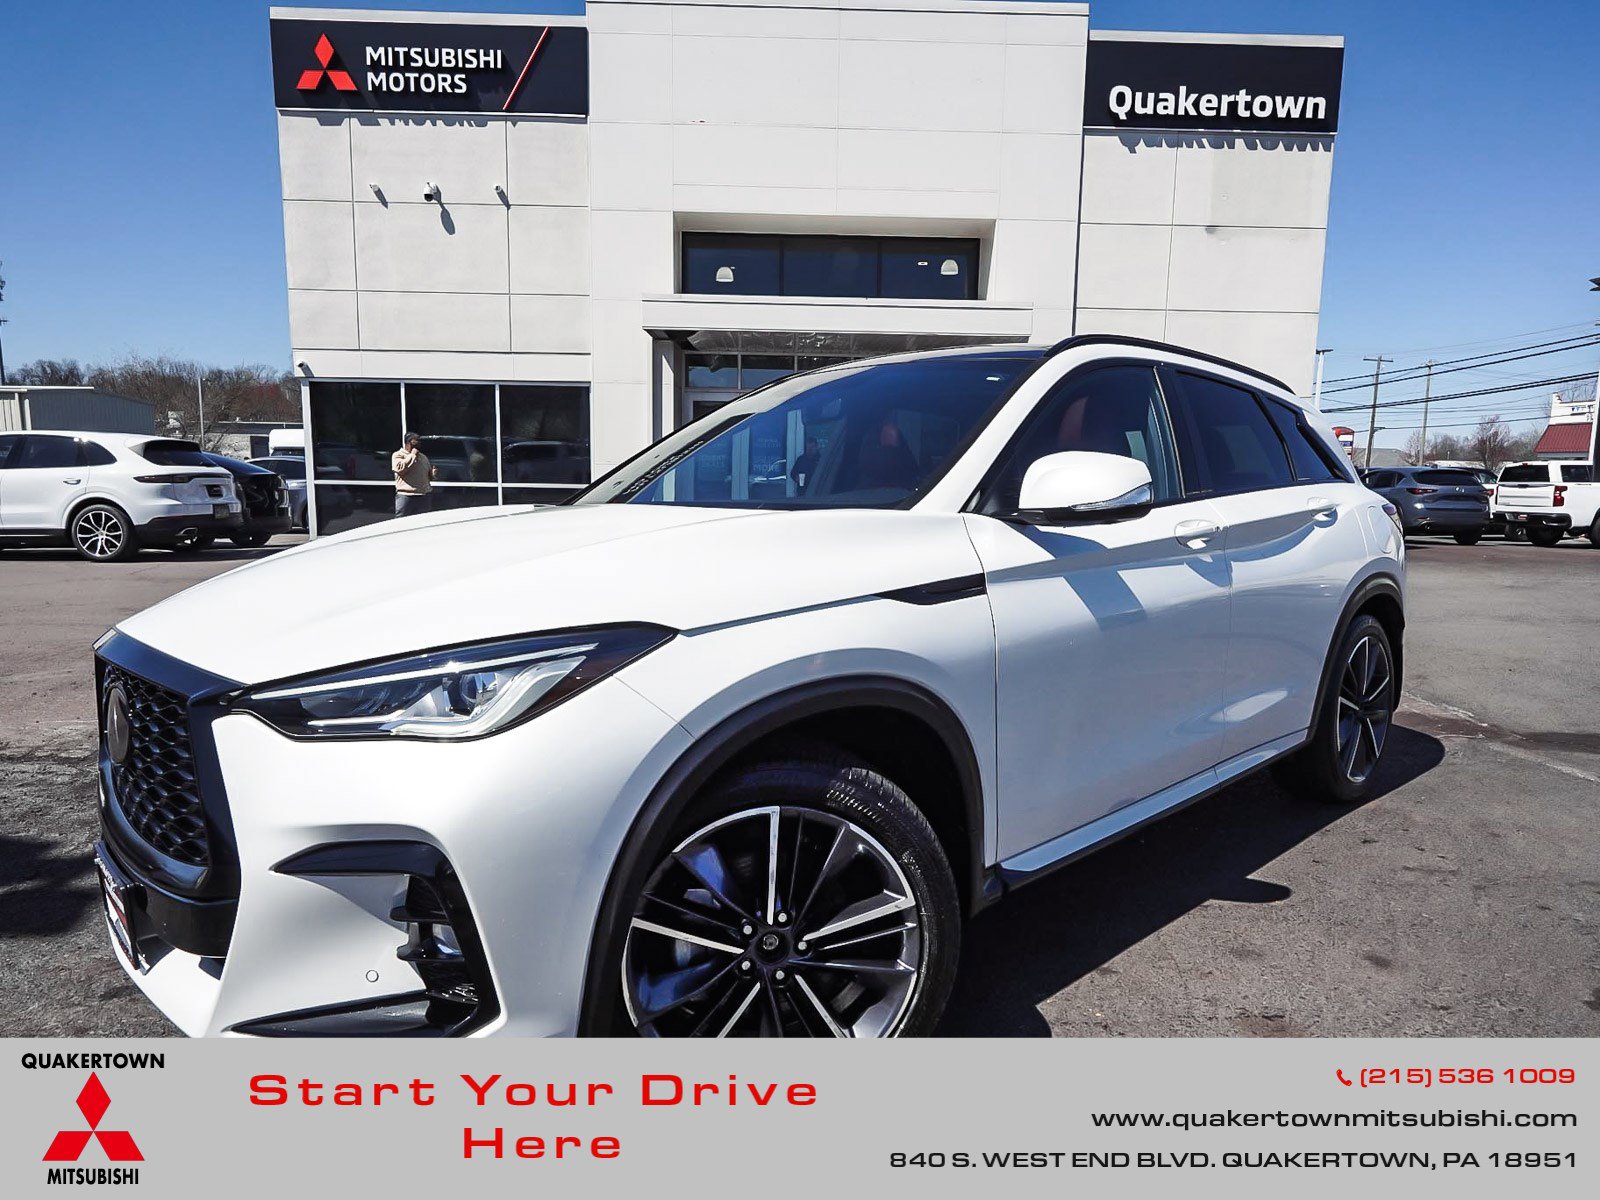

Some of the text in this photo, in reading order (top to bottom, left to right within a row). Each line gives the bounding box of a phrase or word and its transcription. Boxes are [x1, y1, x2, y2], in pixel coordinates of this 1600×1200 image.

[365, 46, 502, 69] MITSUBISHI
[366, 71, 467, 94] MOTORS
[1108, 84, 1327, 120] Quakertown
